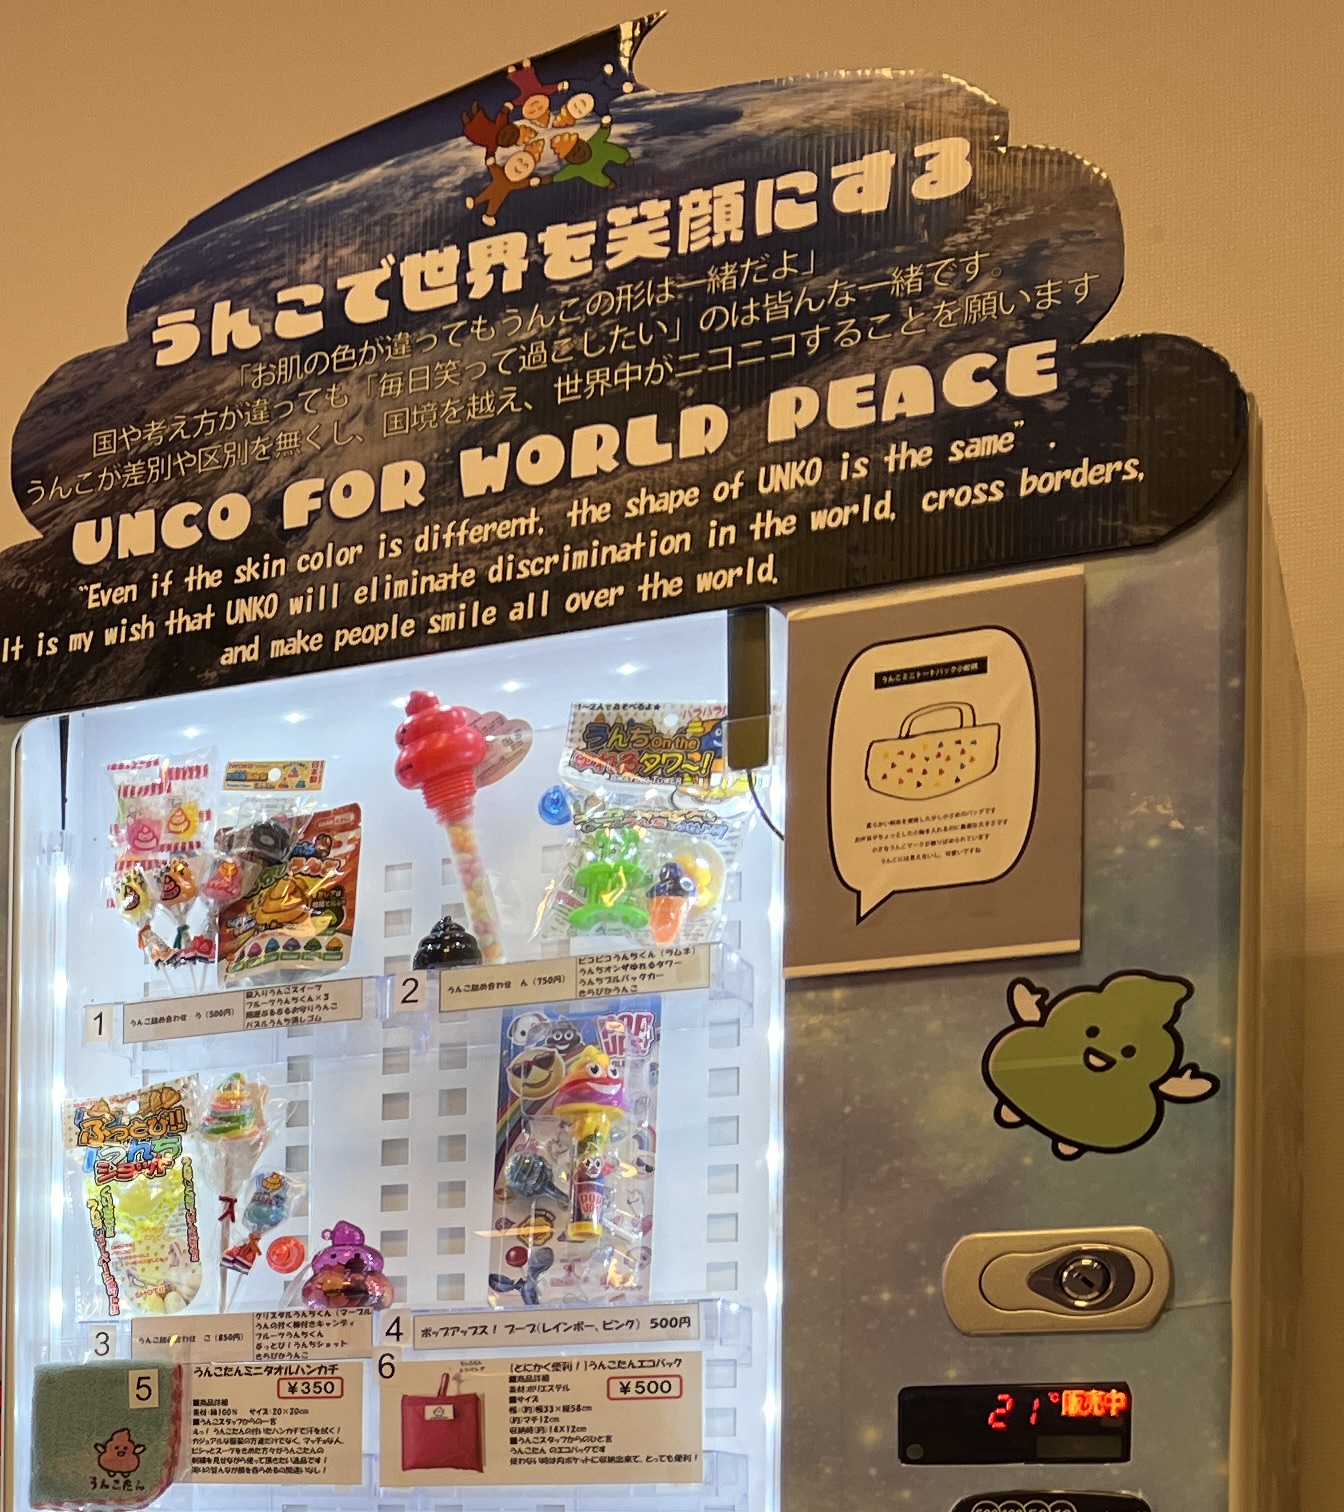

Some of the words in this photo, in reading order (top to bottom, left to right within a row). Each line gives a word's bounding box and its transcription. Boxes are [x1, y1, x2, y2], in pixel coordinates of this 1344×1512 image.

[150, 135, 976, 368] うんこで世界を笑顔にする
[238, 248, 817, 392] 「お肌の色が違ってもうんこの形は一緒だよ」
[72, 492, 252, 566] UNCO
[282, 460, 427, 530] FOR
[459, 404, 730, 498] WORLD
[767, 338, 1059, 445] PEACE
[150, 572, 174, 598] if
[186, 563, 223, 592] the
[235, 553, 287, 586] skin
[296, 541, 364, 581] color
[378, 532, 402, 560] is
[413, 508, 546, 554] different,
[566, 495, 612, 529] the
[623, 482, 700, 524] shape
[712, 471, 746, 504] of
[757, 456, 823, 495] UNKO
[840, 451, 870, 484] is
[883, 439, 934, 473] the
[2, 636, 25, 663] It
[37, 630, 59, 658] is
[68, 627, 95, 656] my
[104, 613, 155, 646] wish
[165, 604, 215, 639] that
[225, 593, 279, 629] UNKO
[289, 580, 340, 618] will
[353, 563, 476, 606] eliminate
[487, 519, 692, 588] discrimination
[709, 517, 737, 550] in
[750, 508, 797, 542] the
[810, 490, 898, 533] world,
[920, 482, 1006, 515] cross
[1019, 456, 1145, 500] borders,
[220, 636, 260, 667] and
[270, 625, 323, 659] make
[334, 613, 416, 657] people
[428, 601, 497, 638] smile
[509, 591, 549, 624] all
[565, 584, 626, 615] over
[638, 571, 684, 605] the
[696, 553, 780, 594] world.
[401, 977, 419, 1004] 2
[94, 1011, 104, 1036] 1
[385, 1316, 403, 1341] 4
[649, 1316, 692, 1330] 500円
[94, 1332, 110, 1355] 3
[194, 1364, 340, 1377] うんこたんミニタオルハンカチ
[378, 1353, 395, 1378] 6
[135, 1376, 152, 1401] 5
[1061, 1388, 1127, 1417] 販売中
[89, 1476, 145, 1491] うんこたん
